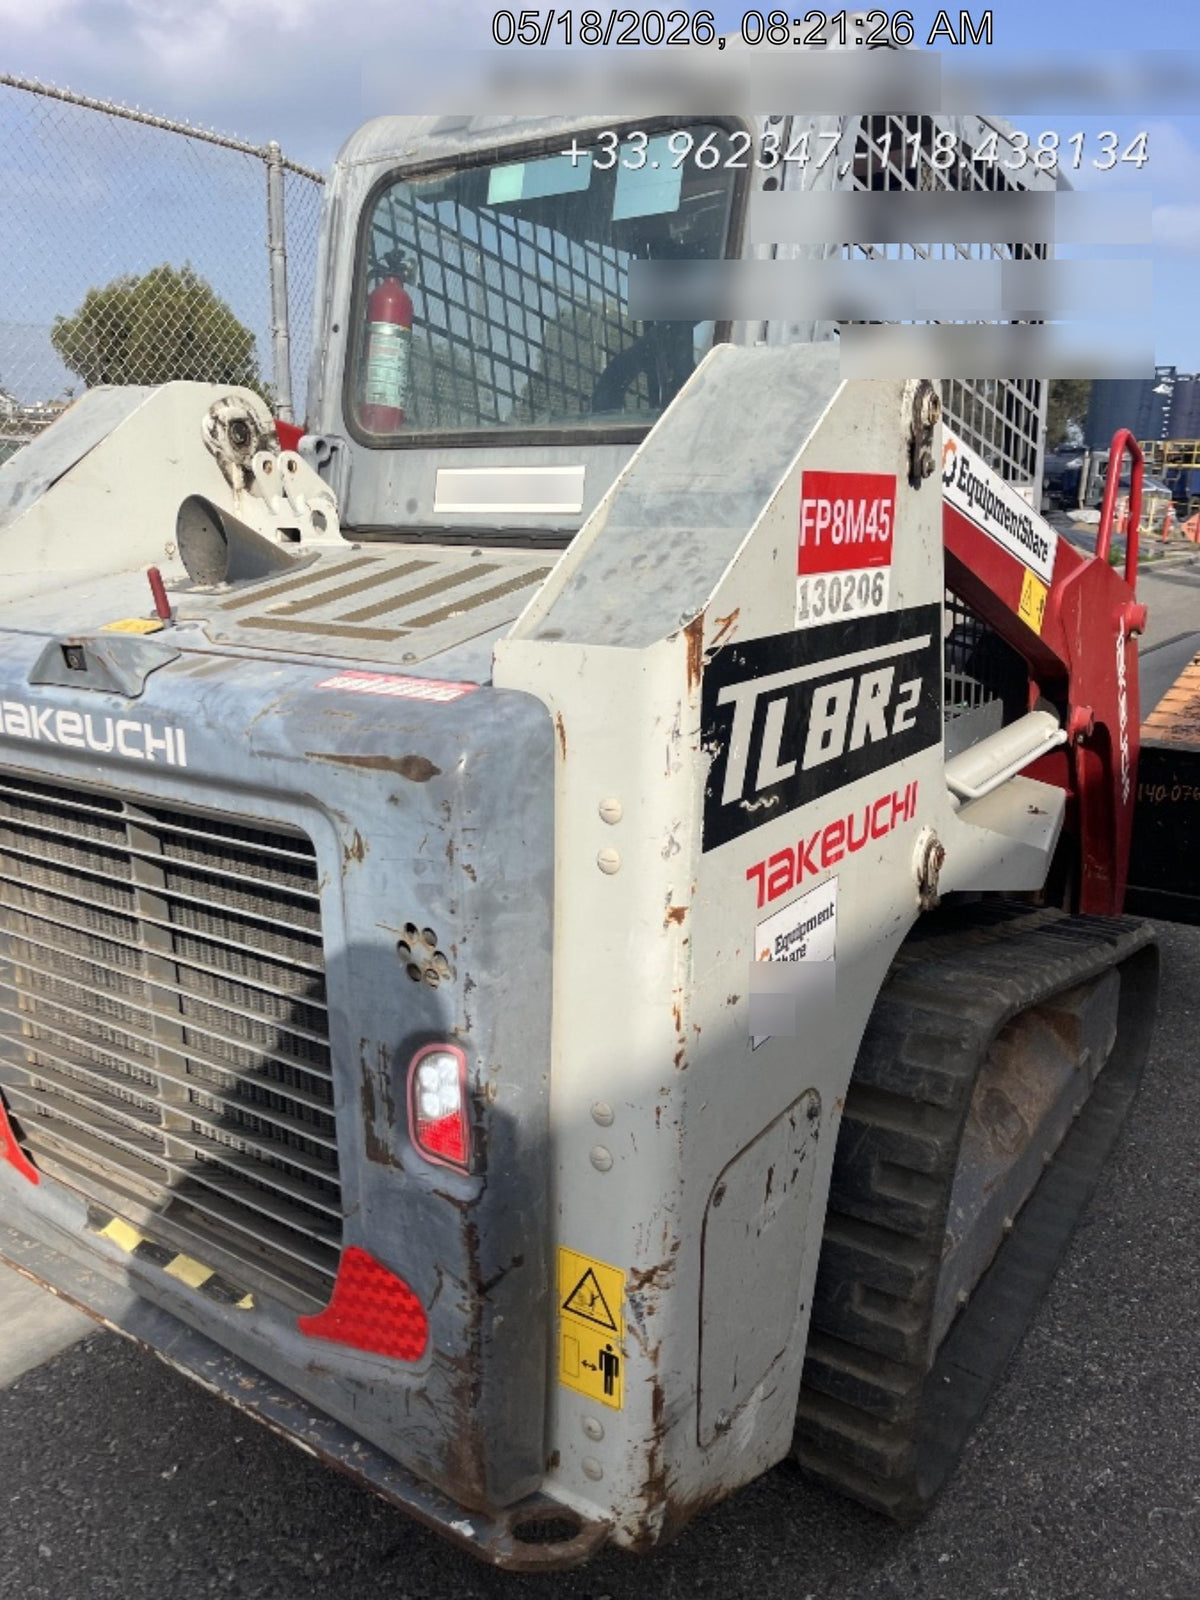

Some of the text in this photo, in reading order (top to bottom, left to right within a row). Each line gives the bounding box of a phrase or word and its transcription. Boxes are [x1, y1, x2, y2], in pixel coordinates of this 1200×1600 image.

[799, 498, 892, 547] FP8M45
[956, 455, 1050, 564] EquipmentShare
[798, 571, 885, 621] 130206
[774, 902, 835, 956] Equipment
[775, 943, 807, 961] are
